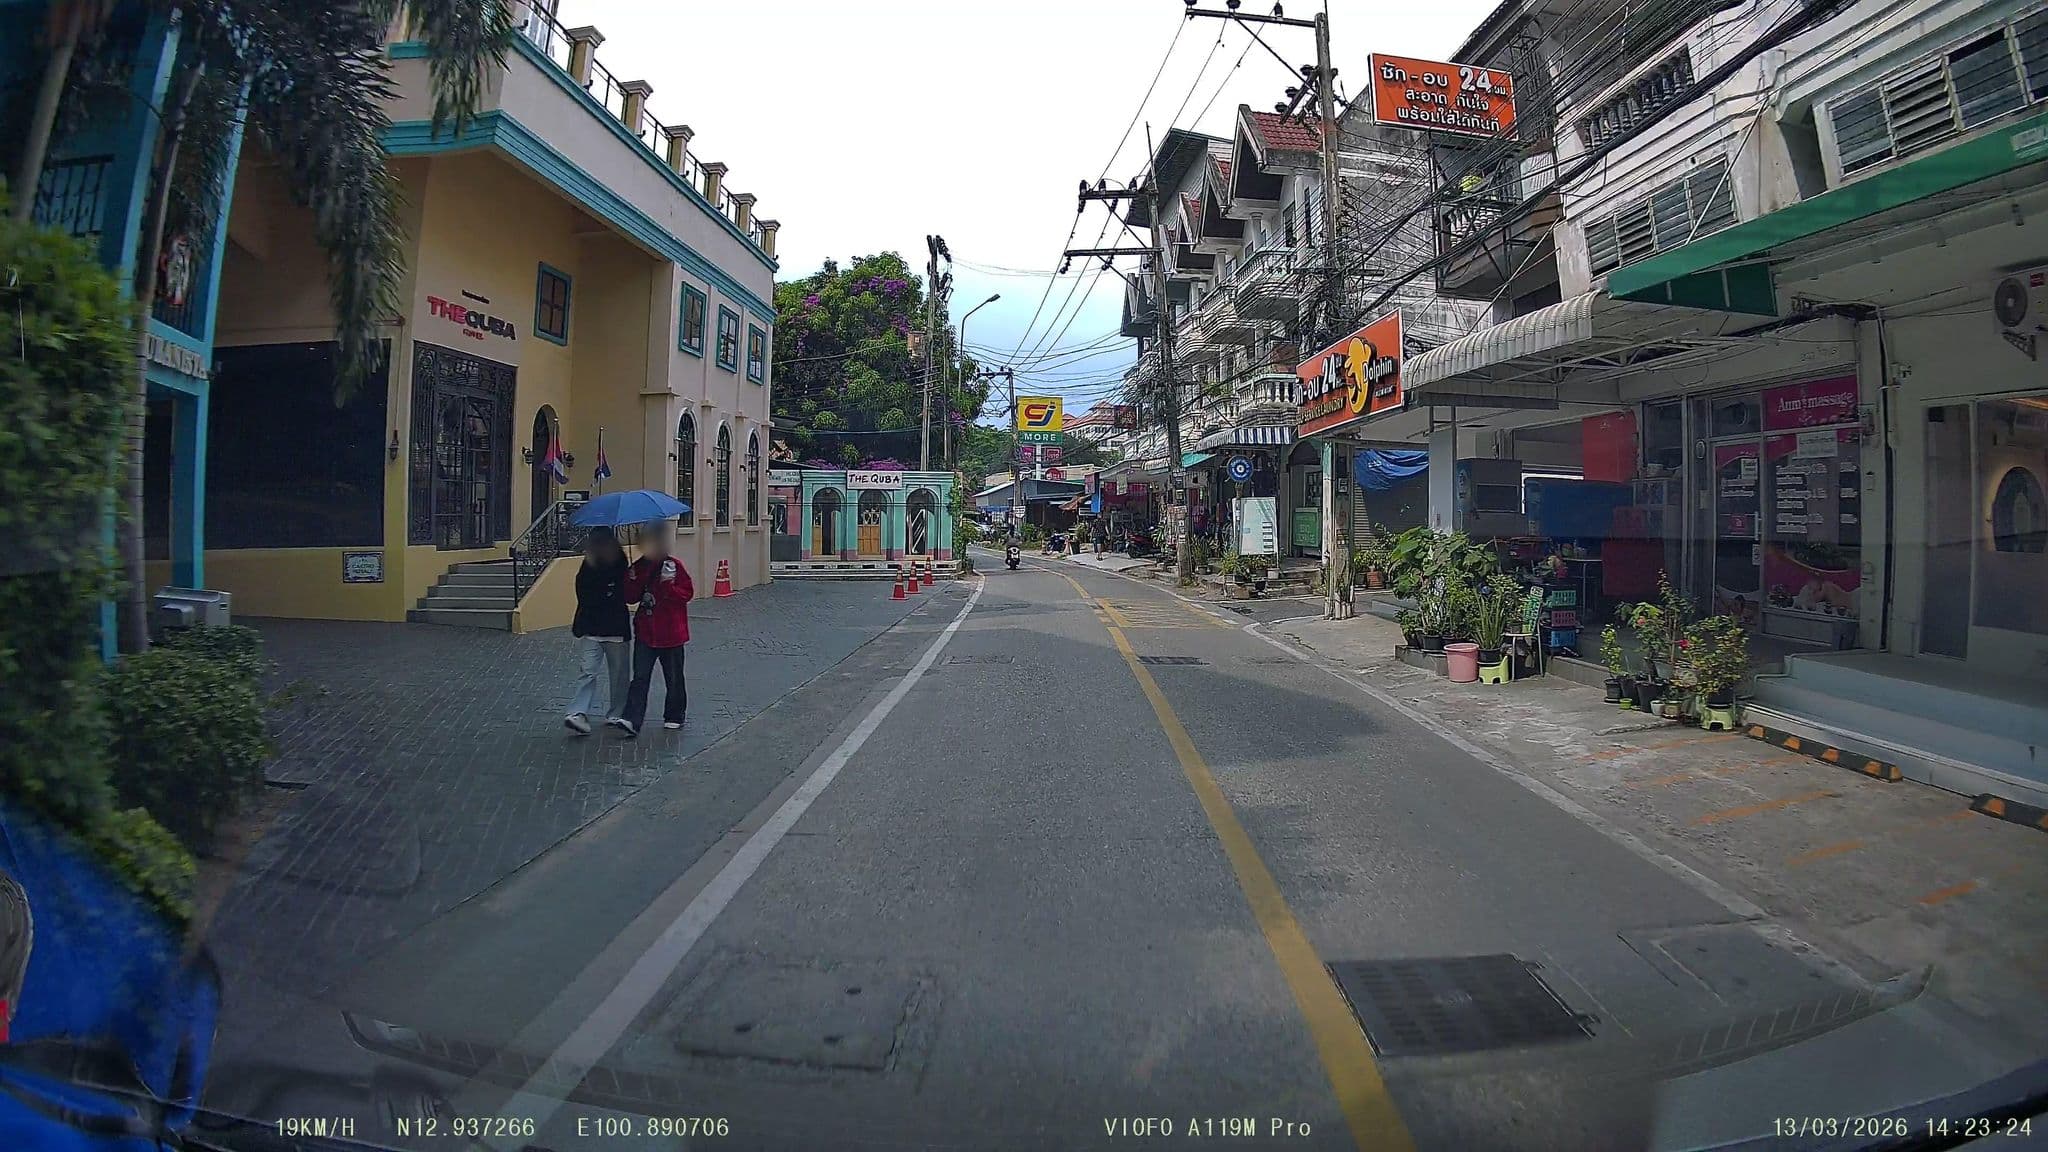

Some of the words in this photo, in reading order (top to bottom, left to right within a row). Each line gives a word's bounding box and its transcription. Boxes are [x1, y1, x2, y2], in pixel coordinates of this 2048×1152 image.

[1459, 66, 1492, 92] 24
[1405, 88, 1448, 105] สะอาด
[1321, 353, 1337, 394] 24
[1362, 356, 1393, 384] Dolphin
[1807, 391, 1855, 408] massage
[1024, 433, 1057, 442] MORE
[848, 473, 869, 484] THE
[870, 473, 901, 484] QUBA
